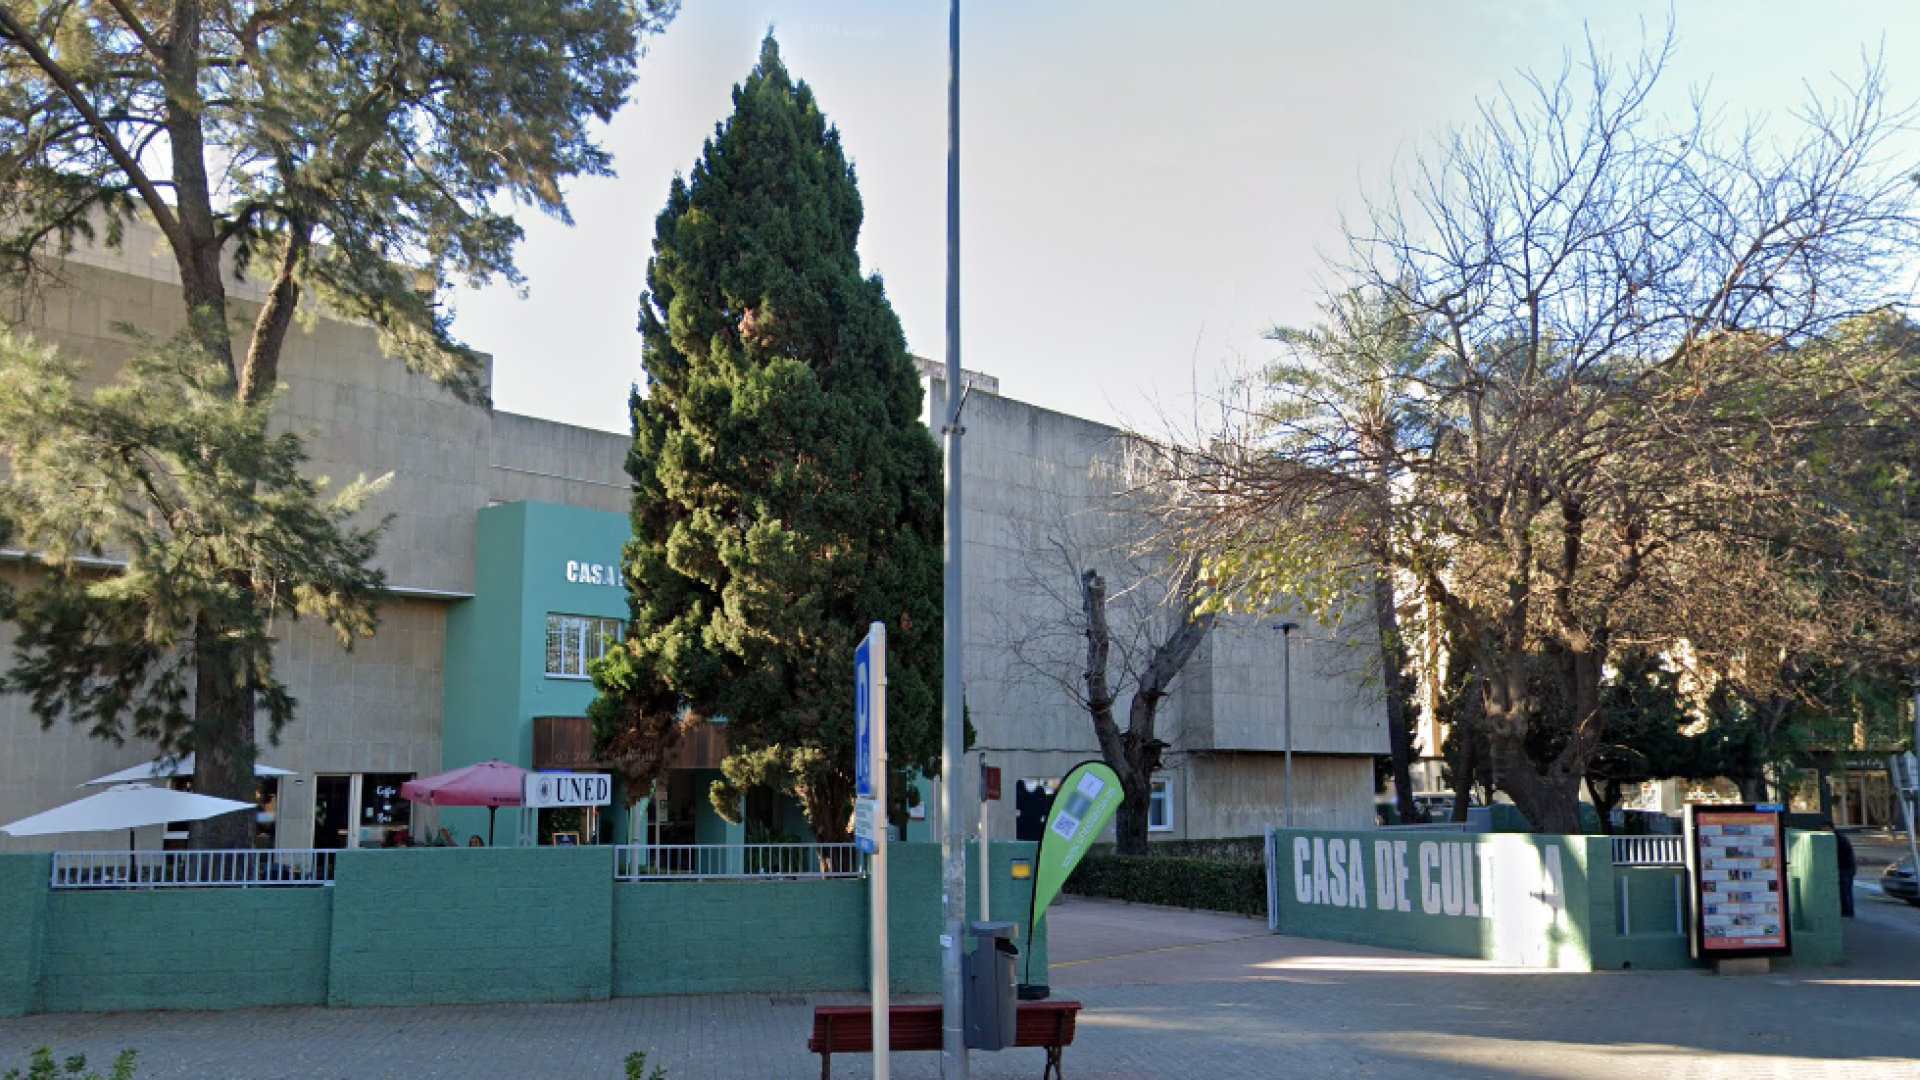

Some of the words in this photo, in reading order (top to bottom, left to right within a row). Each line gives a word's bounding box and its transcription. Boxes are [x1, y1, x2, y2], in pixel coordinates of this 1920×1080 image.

[566, 559, 616, 587] CASA
[857, 662, 868, 776] P
[556, 777, 608, 803] UNED
[1293, 836, 1368, 909] CASA
[1374, 840, 1412, 913] DE
